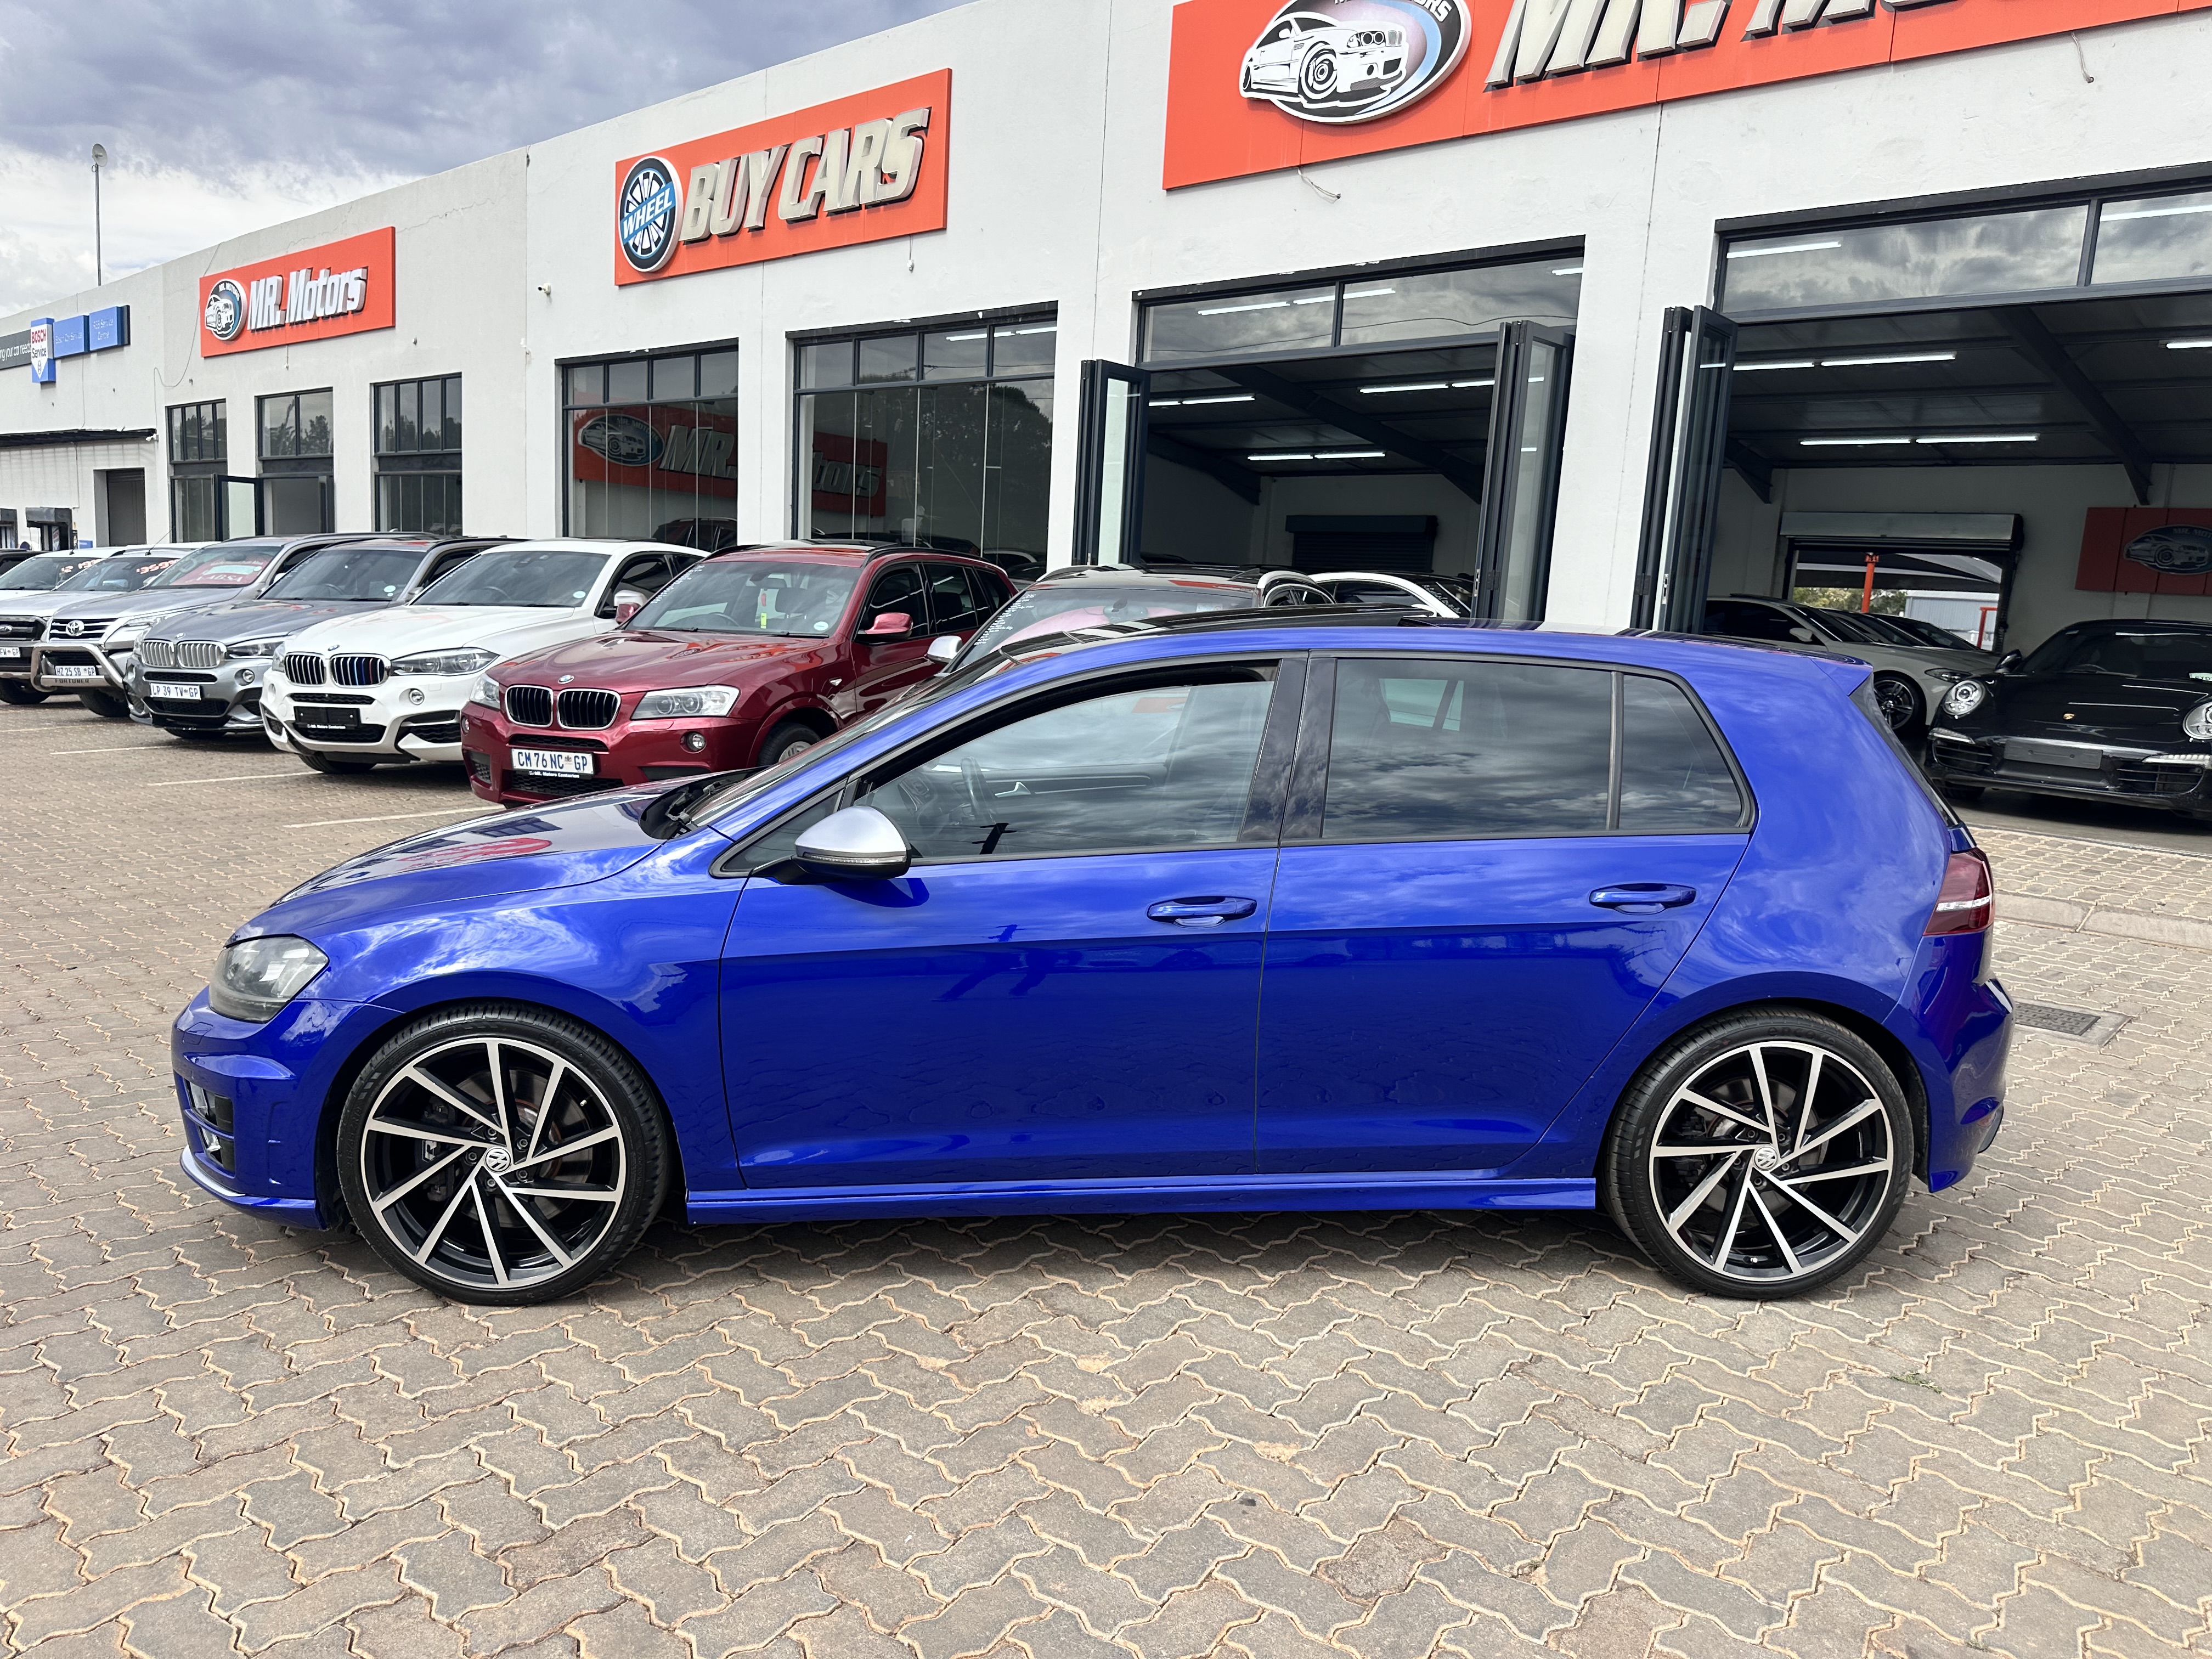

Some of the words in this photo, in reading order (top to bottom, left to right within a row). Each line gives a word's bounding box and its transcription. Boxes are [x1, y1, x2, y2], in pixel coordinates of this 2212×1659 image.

[623, 187, 673, 240] WHEEL
[247, 274, 286, 332] MR.
[285, 267, 368, 325] Motors
[32, 329, 47, 344] BOSCH
[32, 345, 47, 359] Service
[659, 425, 737, 479] MR.
[812, 452, 883, 498] tors
[2193, 528, 2212, 540] MOT
[57, 667, 64, 676] HZ
[65, 667, 72, 675] 25
[74, 667, 81, 675] SB
[88, 667, 95, 675] GP
[153, 687, 160, 696] LP
[163, 687, 171, 696] 39
[174, 687, 183, 697] TV
[189, 687, 198, 697] GP
[518, 752, 532, 768] CM
[534, 753, 548, 769] 76
[550, 754, 564, 769] NC
[574, 755, 588, 771] GP
